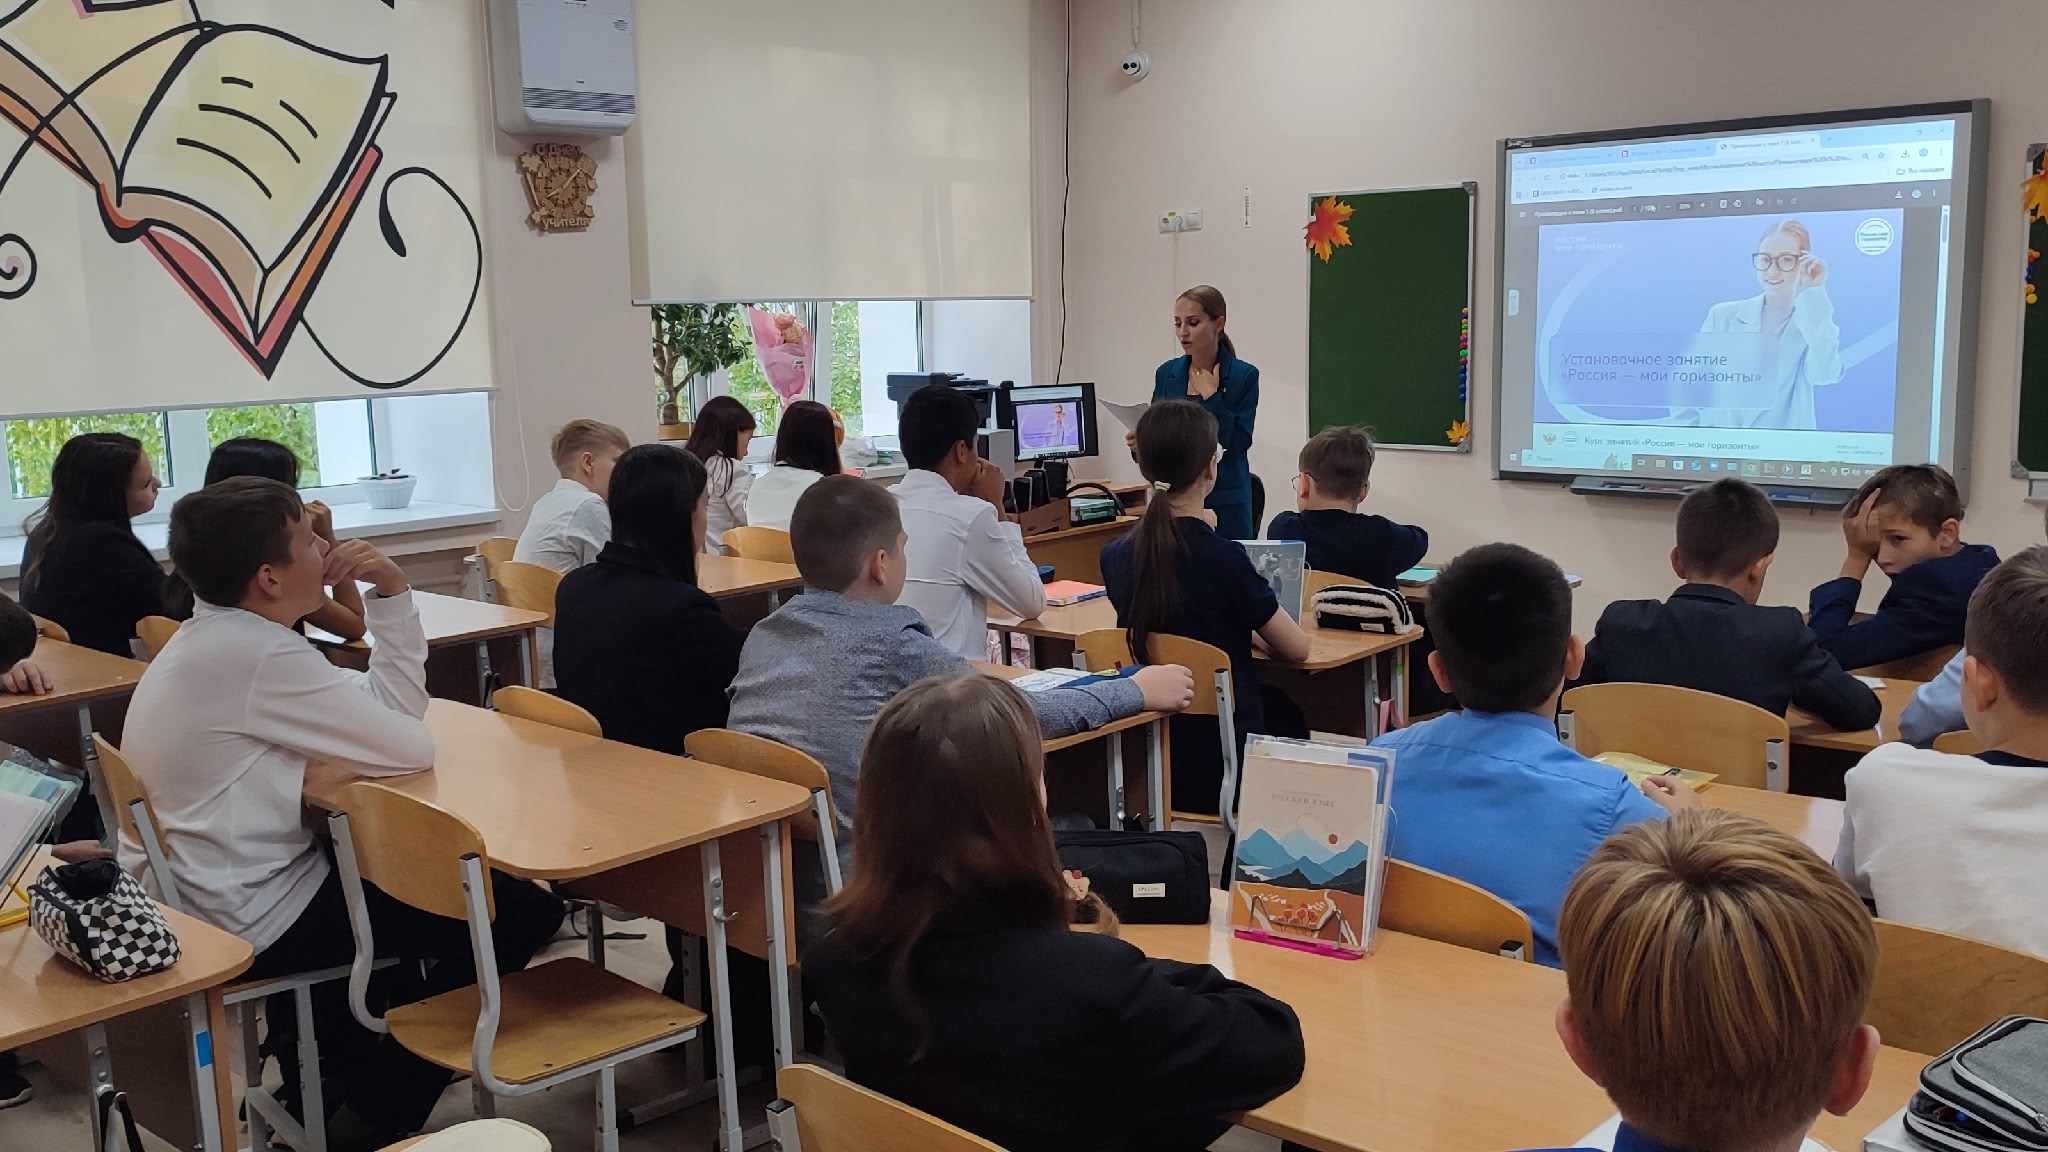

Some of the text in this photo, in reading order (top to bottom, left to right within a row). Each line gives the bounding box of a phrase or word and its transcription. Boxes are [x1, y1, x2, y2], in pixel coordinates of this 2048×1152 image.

[542, 217, 590, 230] учителя
[1562, 353, 1728, 366] Установочное занятие
[1561, 369, 1617, 381] «Россия
[1640, 371, 1668, 382] мои
[1672, 371, 1762, 384] горизонты»
[1584, 436, 1604, 446] Курс
